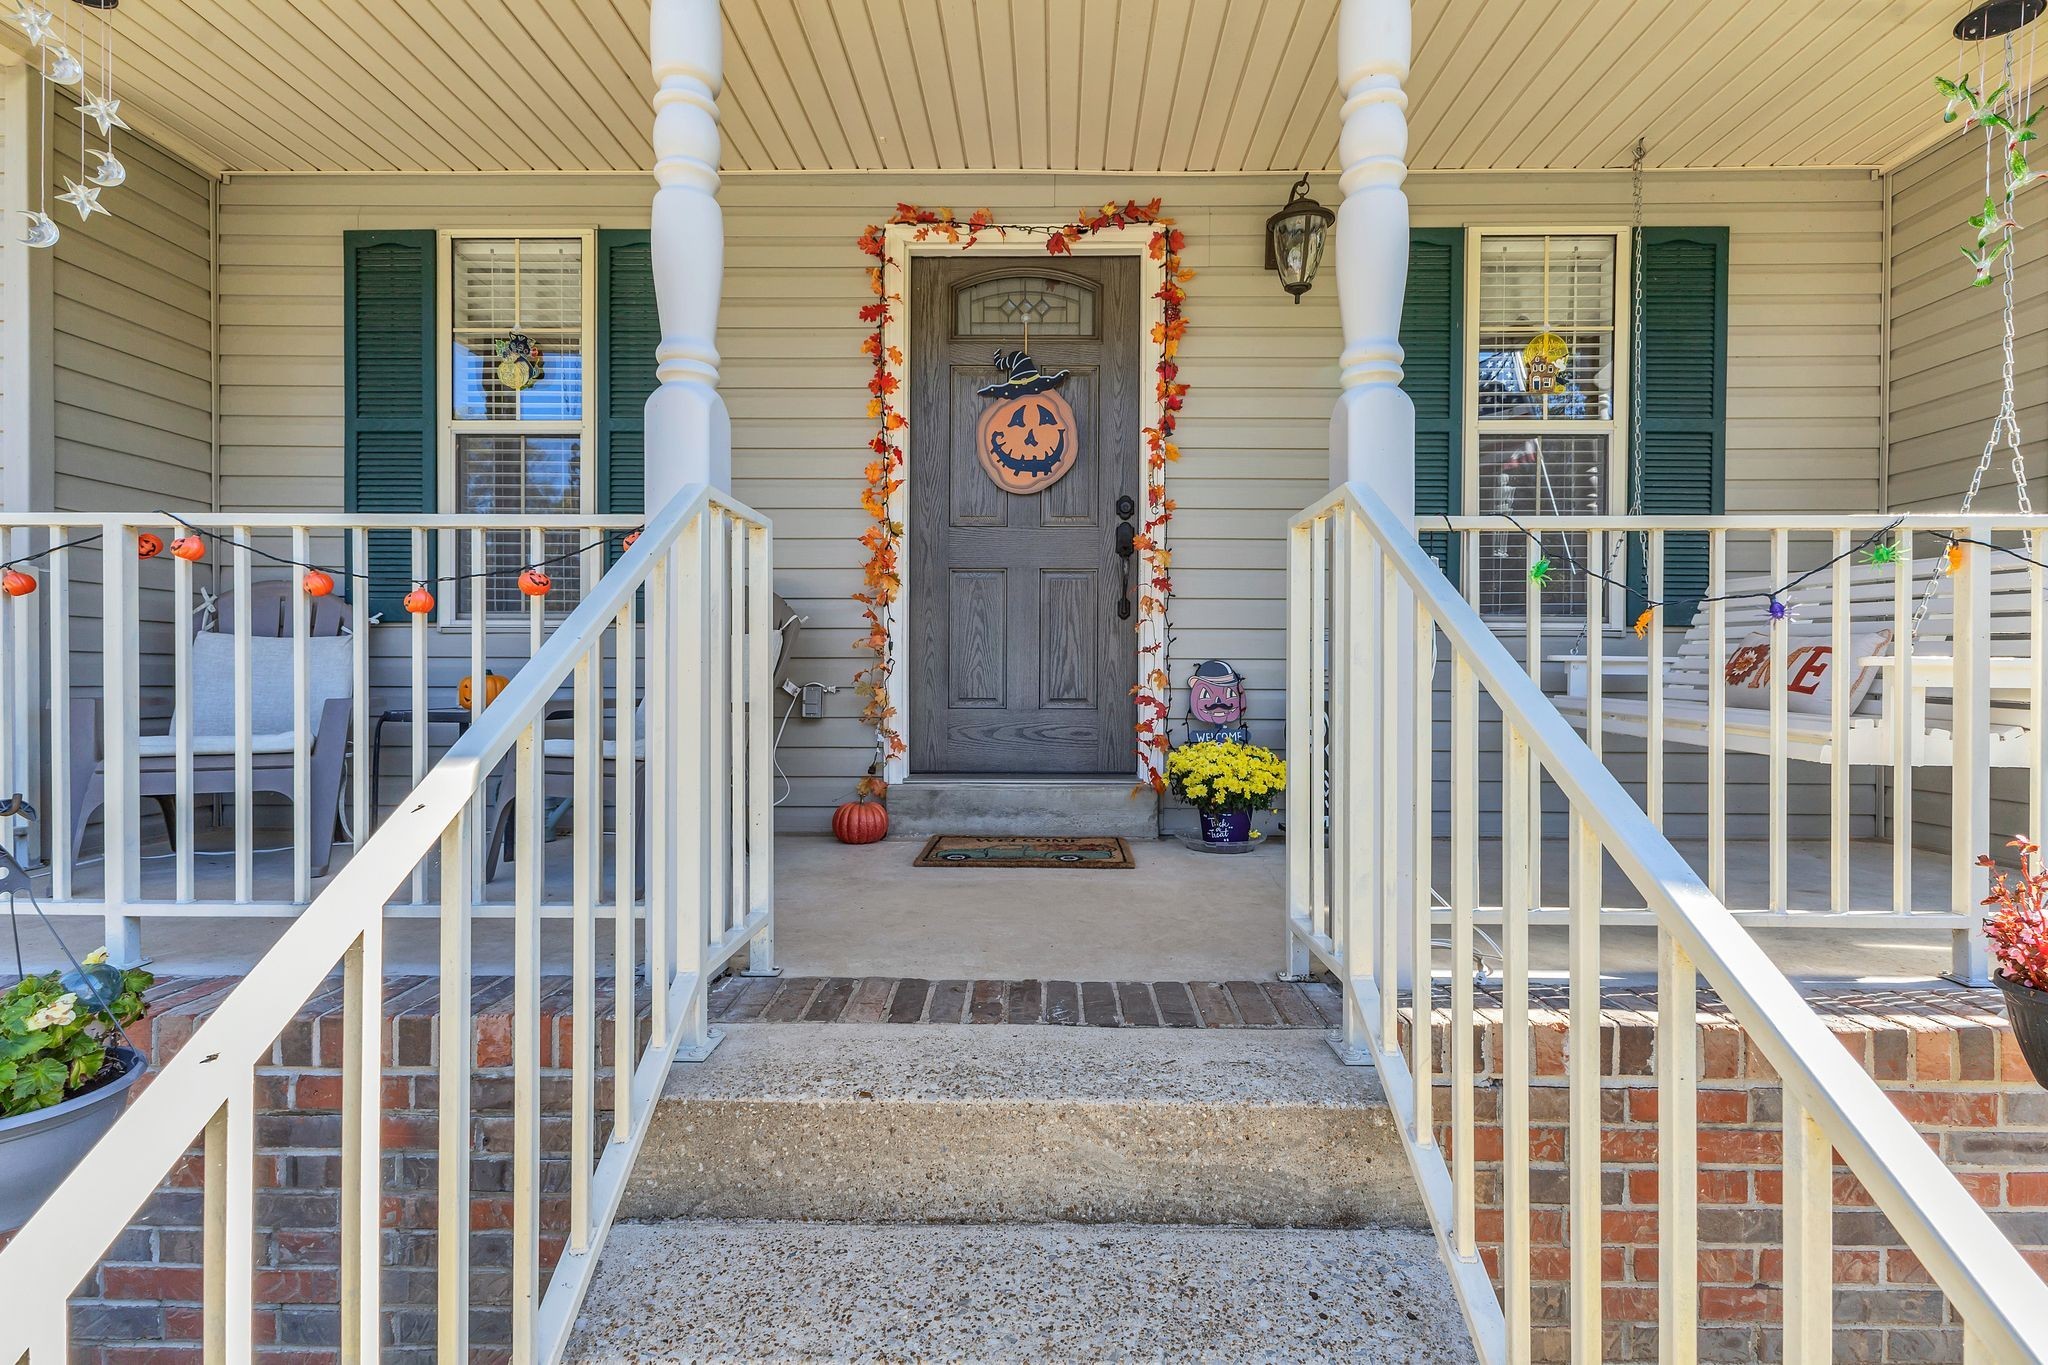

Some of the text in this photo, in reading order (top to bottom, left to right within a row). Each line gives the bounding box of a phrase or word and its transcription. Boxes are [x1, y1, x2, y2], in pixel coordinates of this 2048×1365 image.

[1196, 732, 1242, 742] WELCOME
[1207, 817, 1230, 828] Trick
[1208, 828, 1230, 839] Treat
